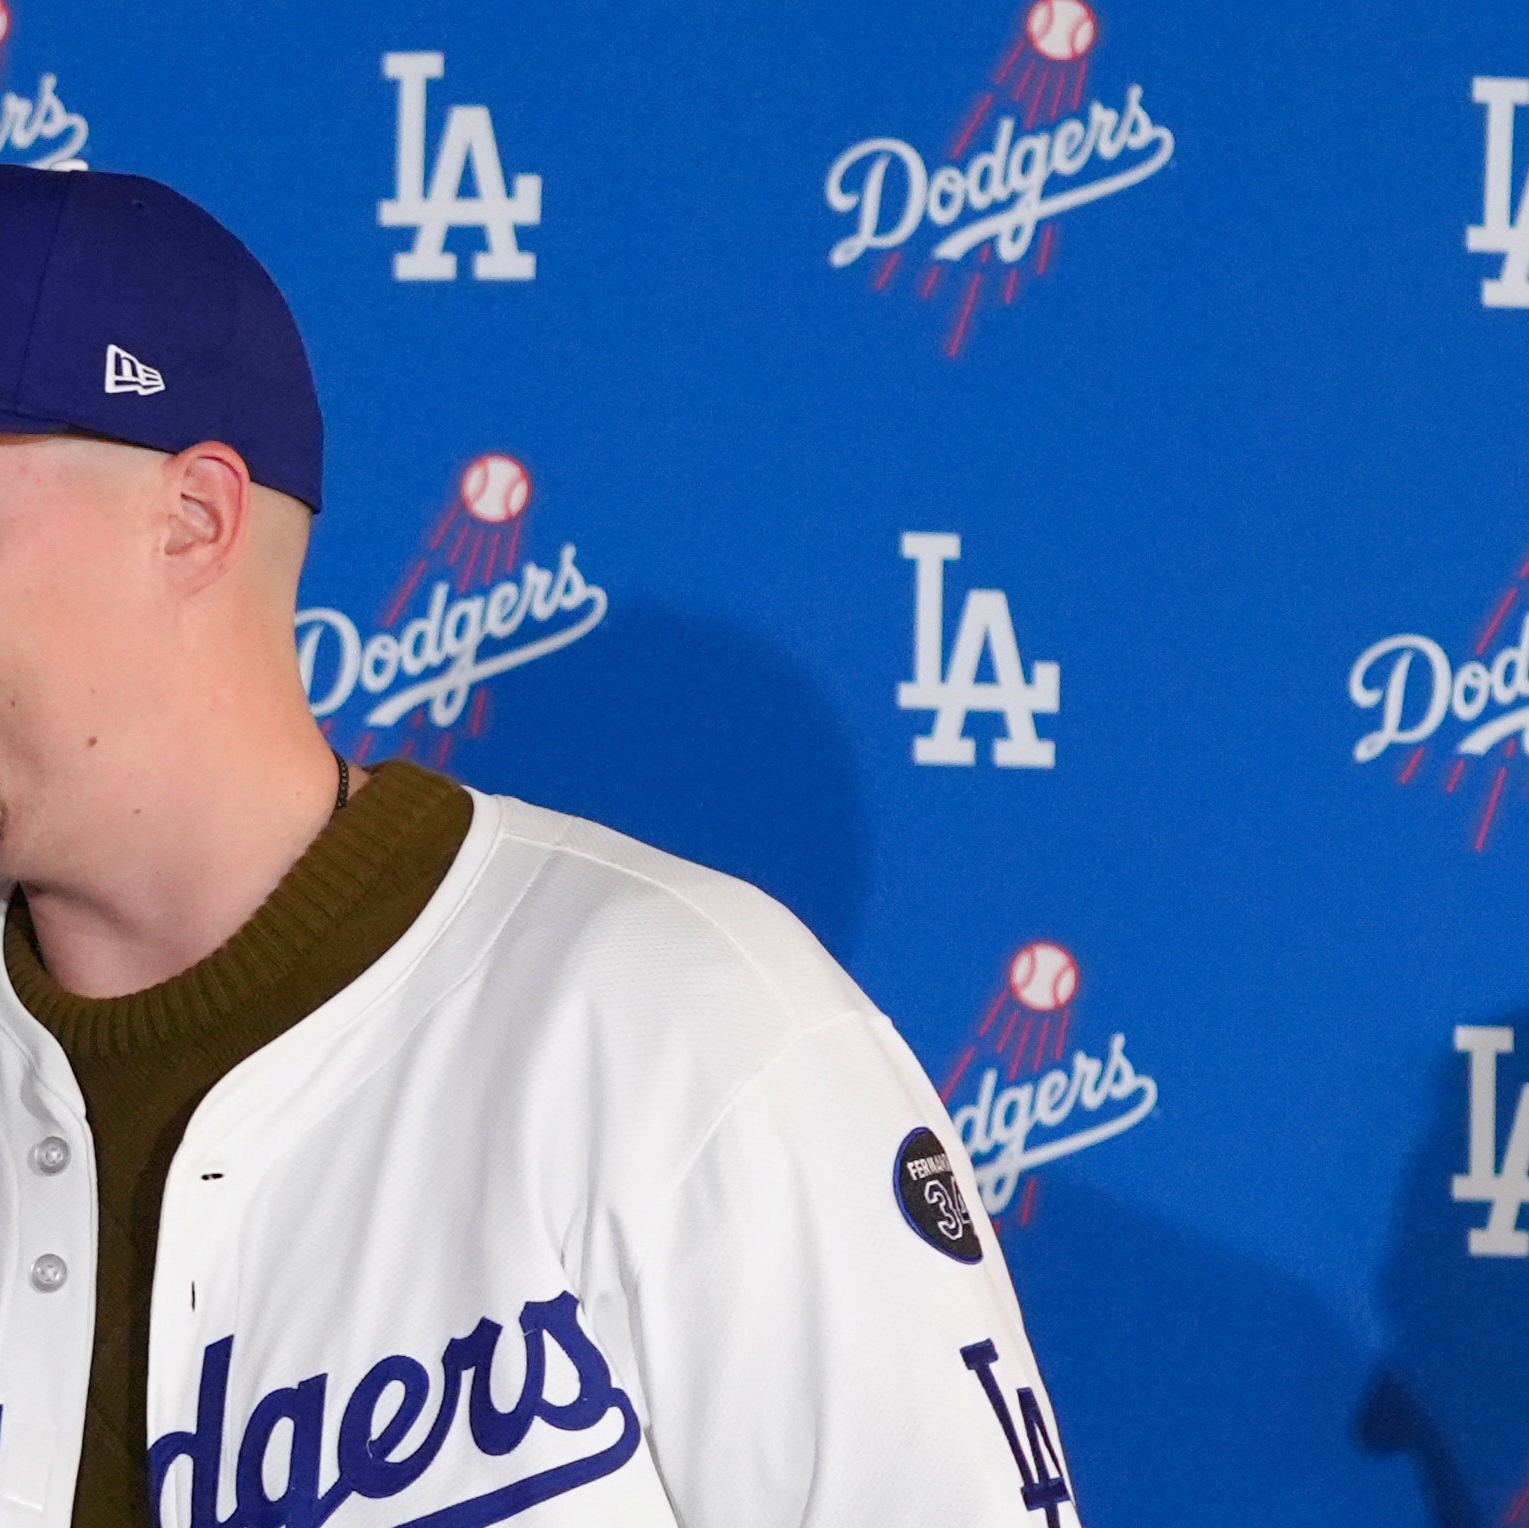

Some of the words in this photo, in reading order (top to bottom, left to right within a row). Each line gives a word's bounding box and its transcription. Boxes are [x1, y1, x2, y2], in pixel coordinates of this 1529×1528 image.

[379, 52, 542, 281] LA
[826, 85, 1174, 267] Dodgers
[897, 531, 1061, 768] LA
